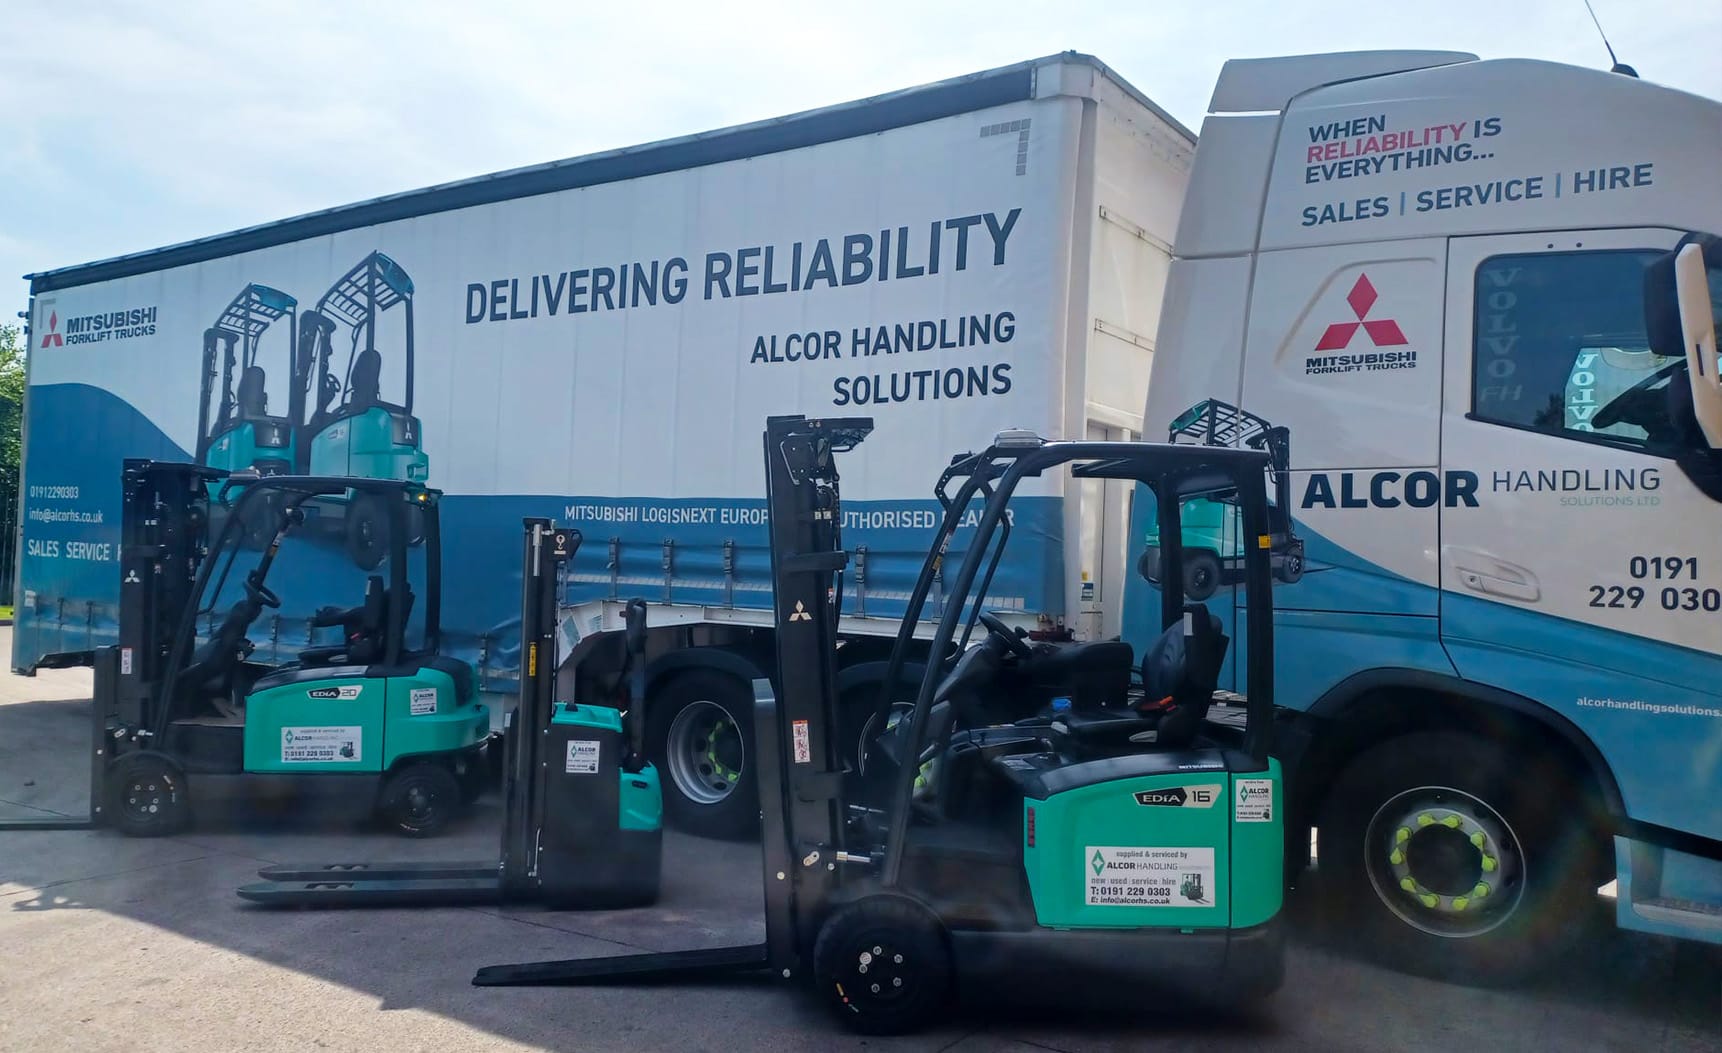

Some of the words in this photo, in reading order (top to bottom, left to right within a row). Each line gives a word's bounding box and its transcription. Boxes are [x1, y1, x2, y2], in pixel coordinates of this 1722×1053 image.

[1307, 121, 1468, 164] RELIABILITY
[1474, 117, 1502, 139] IS
[1309, 114, 1386, 143] WHEN
[1305, 143, 1495, 184] EVERYTHING...
[1302, 196, 1389, 227] SALES
[1416, 176, 1543, 213] SERVICE
[1573, 163, 1653, 194] HIRE
[465, 257, 689, 324] DELIVERING
[704, 208, 1022, 300] RELIABILITY
[66, 306, 157, 334] MITSUBISHI
[1483, 267, 1523, 378] VOLVO
[66, 331, 112, 346] FORKLIFT
[115, 324, 156, 339] TRUCKS
[750, 330, 842, 364] ALCOR
[851, 311, 1016, 358] HANDLING
[1306, 351, 1417, 368] MITSUBISHI
[1306, 365, 1362, 375] FORKLIFT
[1367, 361, 1417, 371] TRUCKS
[832, 363, 1012, 406] SOLUTIONS
[30, 486, 79, 499] 01912290303
[1301, 471, 1479, 509] ALCOR
[1492, 468, 1661, 493] HANDLING
[1559, 496, 1634, 507] SOLUTIONS
[1636, 496, 1661, 507] LTD
[565, 505, 638, 522] MITSUBISHI
[642, 507, 717, 524] LOGISNEXT
[720, 508, 768, 525] EUROP
[840, 510, 935, 529] UTHORISED
[28, 539, 59, 557] SALES
[66, 541, 110, 561] SERVICE
[1629, 556, 1697, 580] 0191
[1589, 585, 1645, 609] 229
[1661, 587, 1721, 612] 030
[341, 688, 357, 696] 20
[1192, 790, 1211, 803] 16
[1106, 862, 1136, 870] ALCOR
[1137, 862, 1178, 871] HANDLING
[1116, 851, 1143, 859] supplied
[1180, 851, 1188, 859] by
[1091, 886, 1099, 895] T:
[1100, 887, 1124, 896] 0191
[1127, 887, 1144, 896] 229
[1147, 887, 1171, 896] 0303
